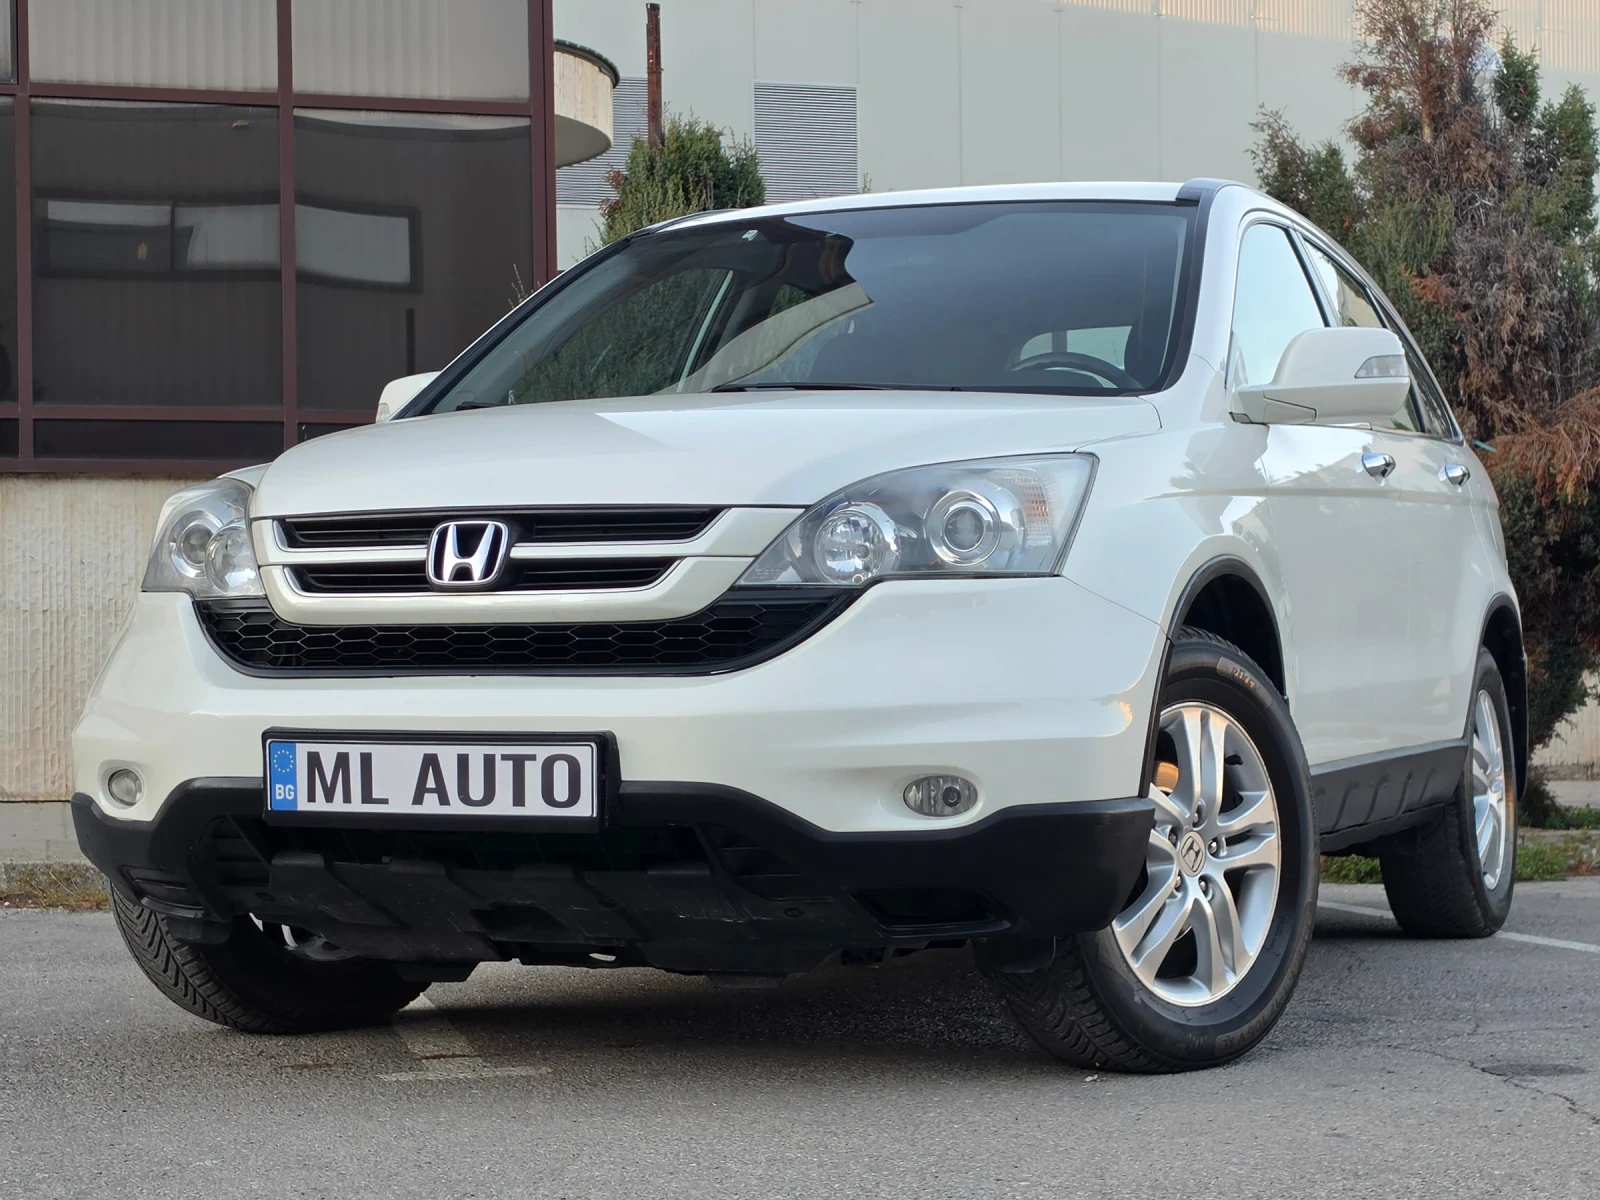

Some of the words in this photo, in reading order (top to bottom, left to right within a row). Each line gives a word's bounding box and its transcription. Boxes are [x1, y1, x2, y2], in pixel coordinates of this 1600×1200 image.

[275, 783, 295, 800] BG
[306, 751, 389, 805] ML
[411, 752, 582, 809] AUTO
